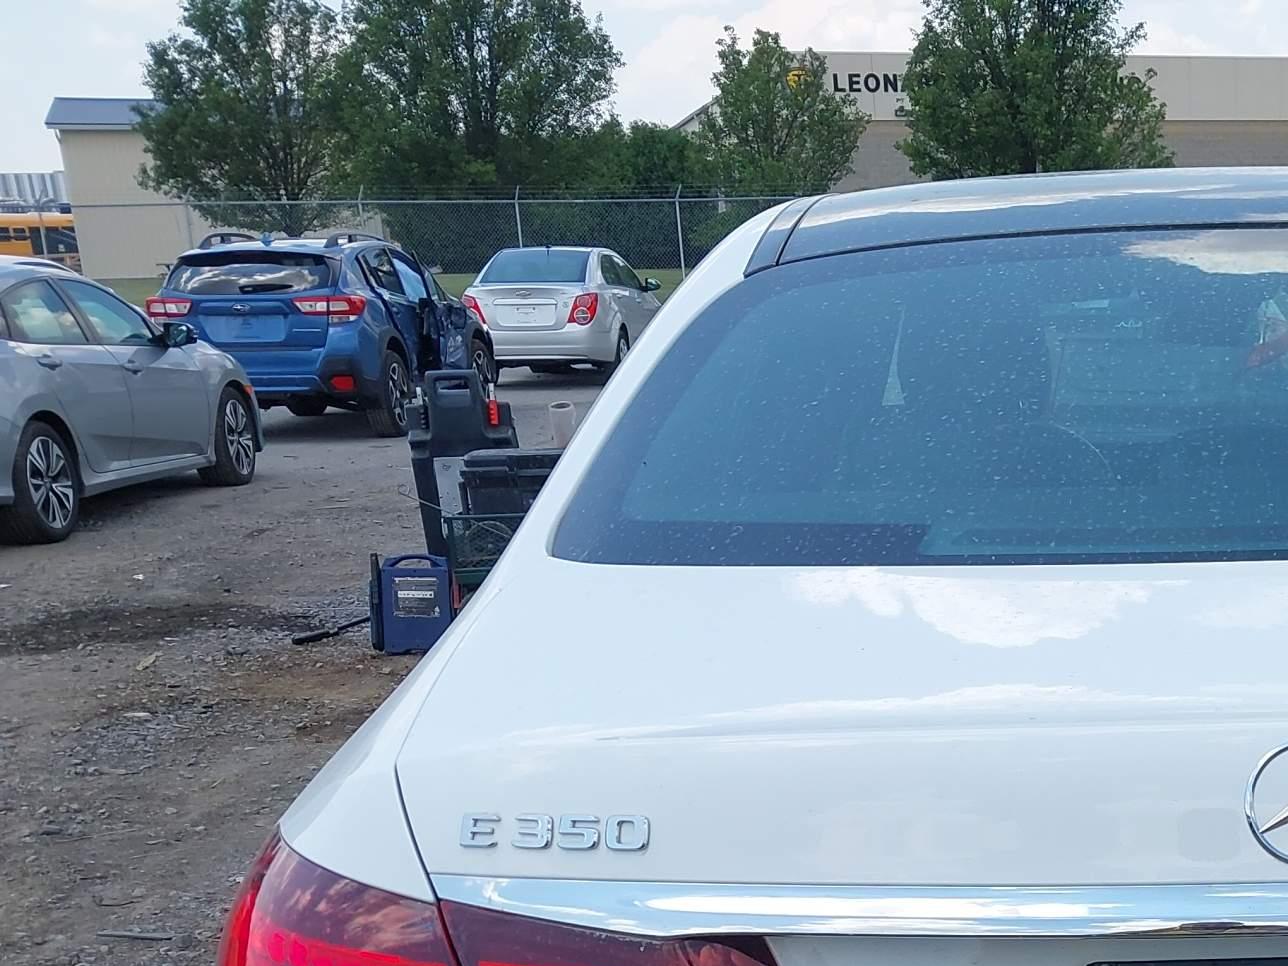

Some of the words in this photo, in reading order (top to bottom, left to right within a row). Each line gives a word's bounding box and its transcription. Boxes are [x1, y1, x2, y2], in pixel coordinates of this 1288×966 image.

[832, 73, 907, 93] LEON
[459, 813, 502, 848] E
[511, 813, 651, 852] 350
